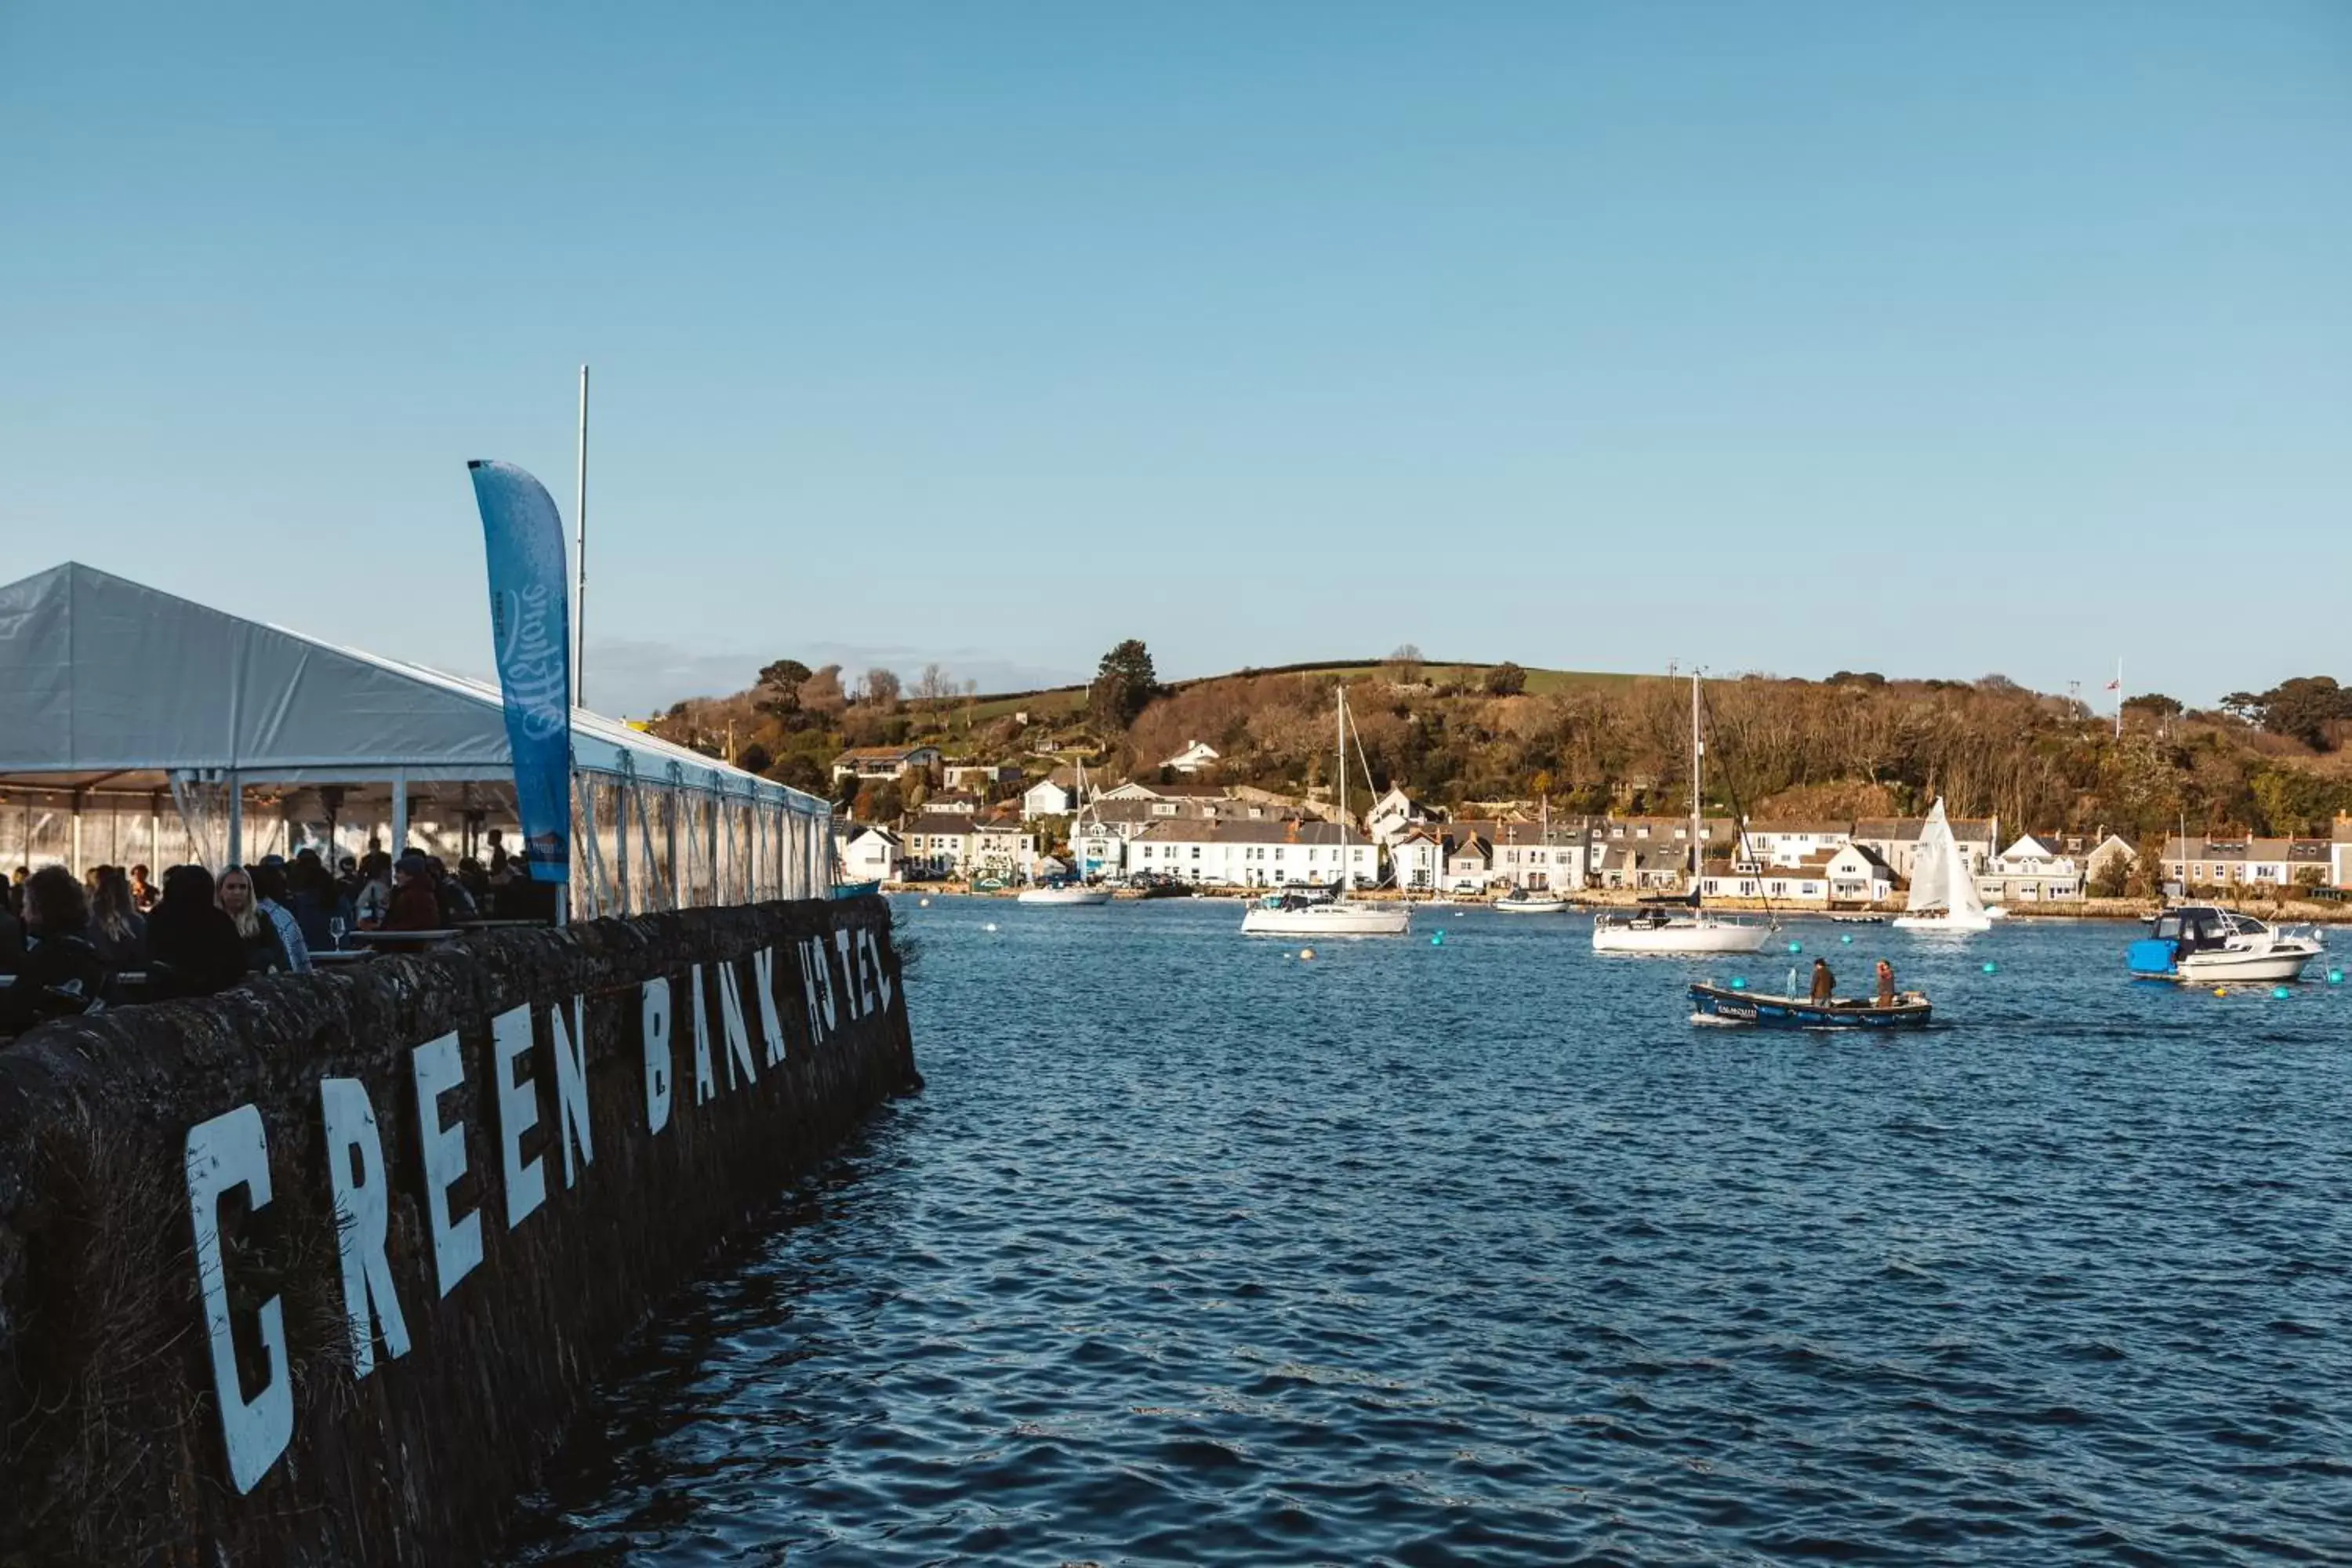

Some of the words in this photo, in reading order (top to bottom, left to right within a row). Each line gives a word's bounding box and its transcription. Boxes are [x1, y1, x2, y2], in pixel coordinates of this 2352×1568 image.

[185, 995, 593, 1495] GREEN
[643, 946, 786, 1135] BANK
[799, 927, 891, 1045] HOTEL
